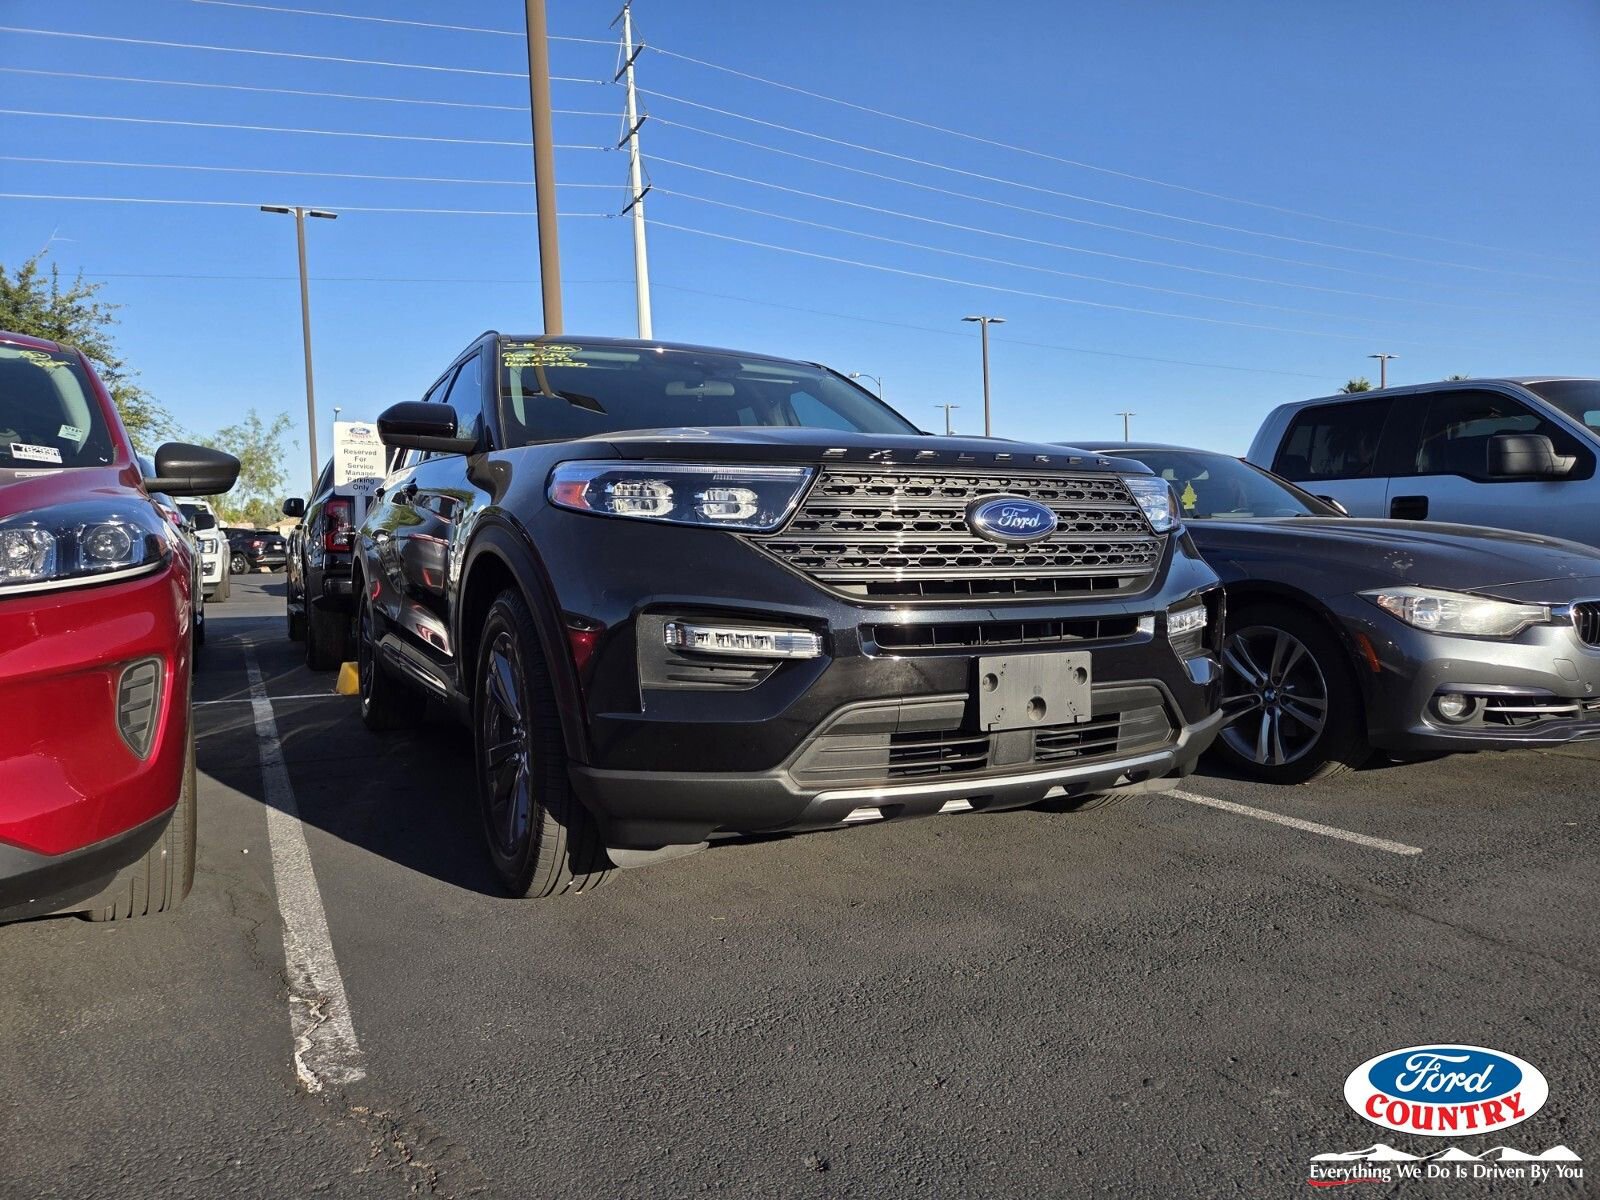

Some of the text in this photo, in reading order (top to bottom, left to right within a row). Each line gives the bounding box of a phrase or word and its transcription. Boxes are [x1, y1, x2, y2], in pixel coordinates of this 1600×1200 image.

[343, 448, 377, 456] Reserved
[821, 447, 1113, 467] EXPLORER
[347, 476, 375, 484] Parking
[997, 506, 1041, 529] Ford
